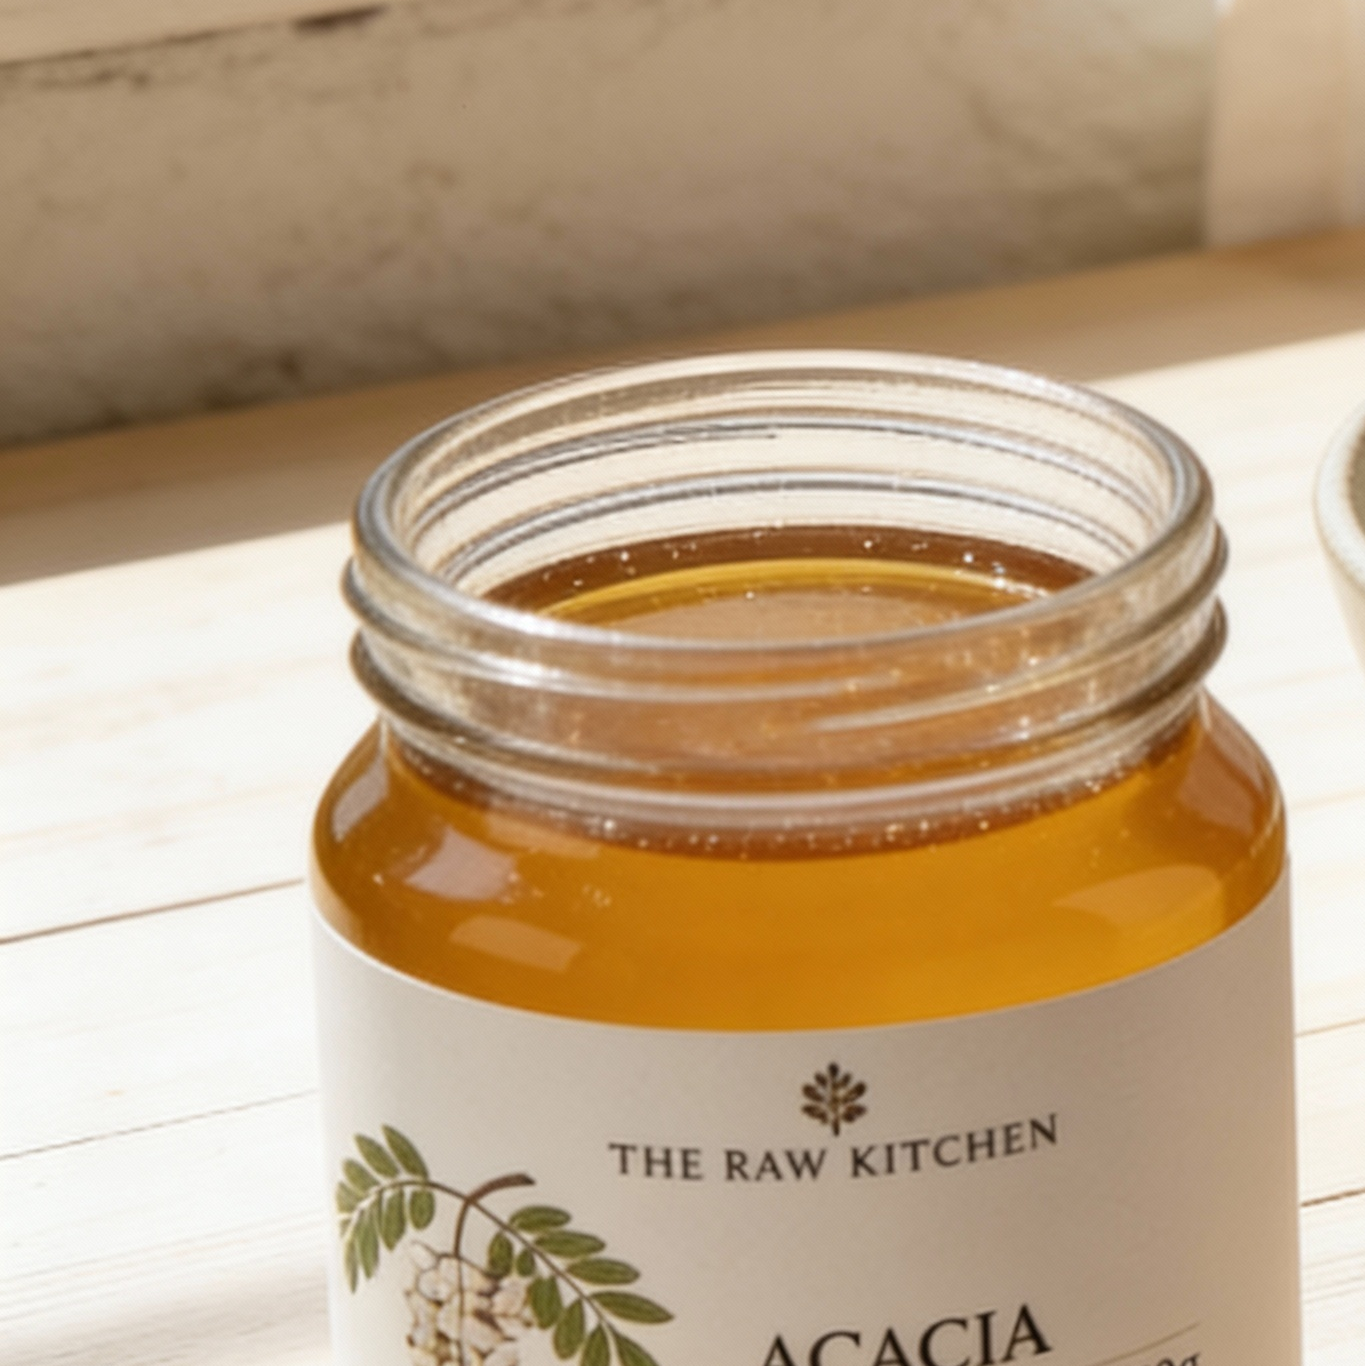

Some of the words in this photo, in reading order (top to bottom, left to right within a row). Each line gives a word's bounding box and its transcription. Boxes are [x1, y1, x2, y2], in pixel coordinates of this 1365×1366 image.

[607, 1142, 704, 1181] THE
[723, 1148, 828, 1182] RAW
[849, 1112, 1059, 1179] KITCHEN
